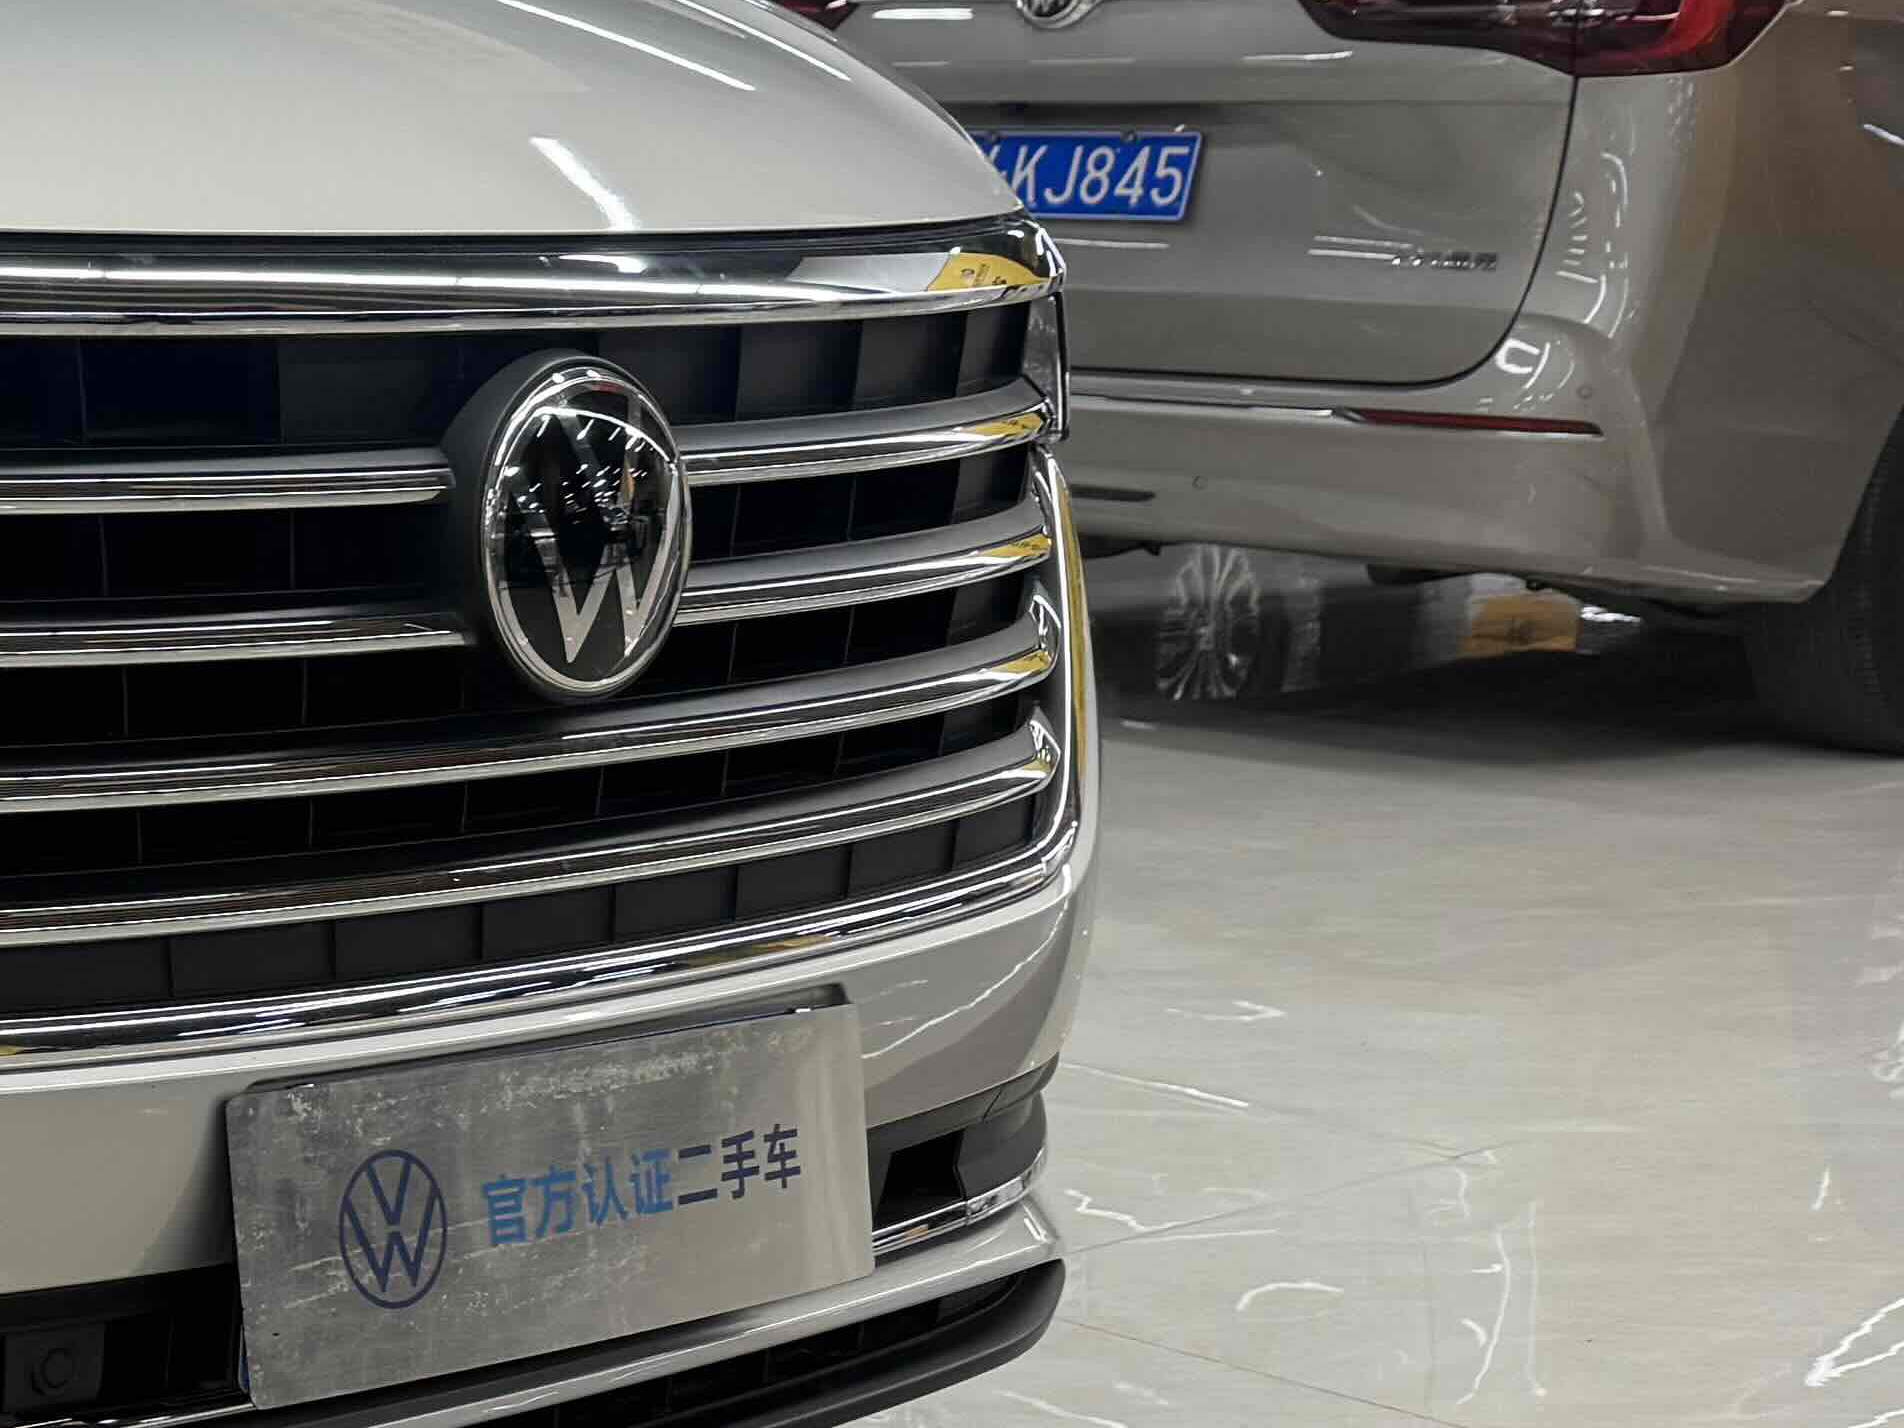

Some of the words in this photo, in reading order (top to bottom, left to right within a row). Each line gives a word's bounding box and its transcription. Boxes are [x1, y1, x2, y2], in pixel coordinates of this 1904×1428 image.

[990, 144, 1190, 206] KJ845
[482, 1123, 801, 1245] 官方认证二手车
